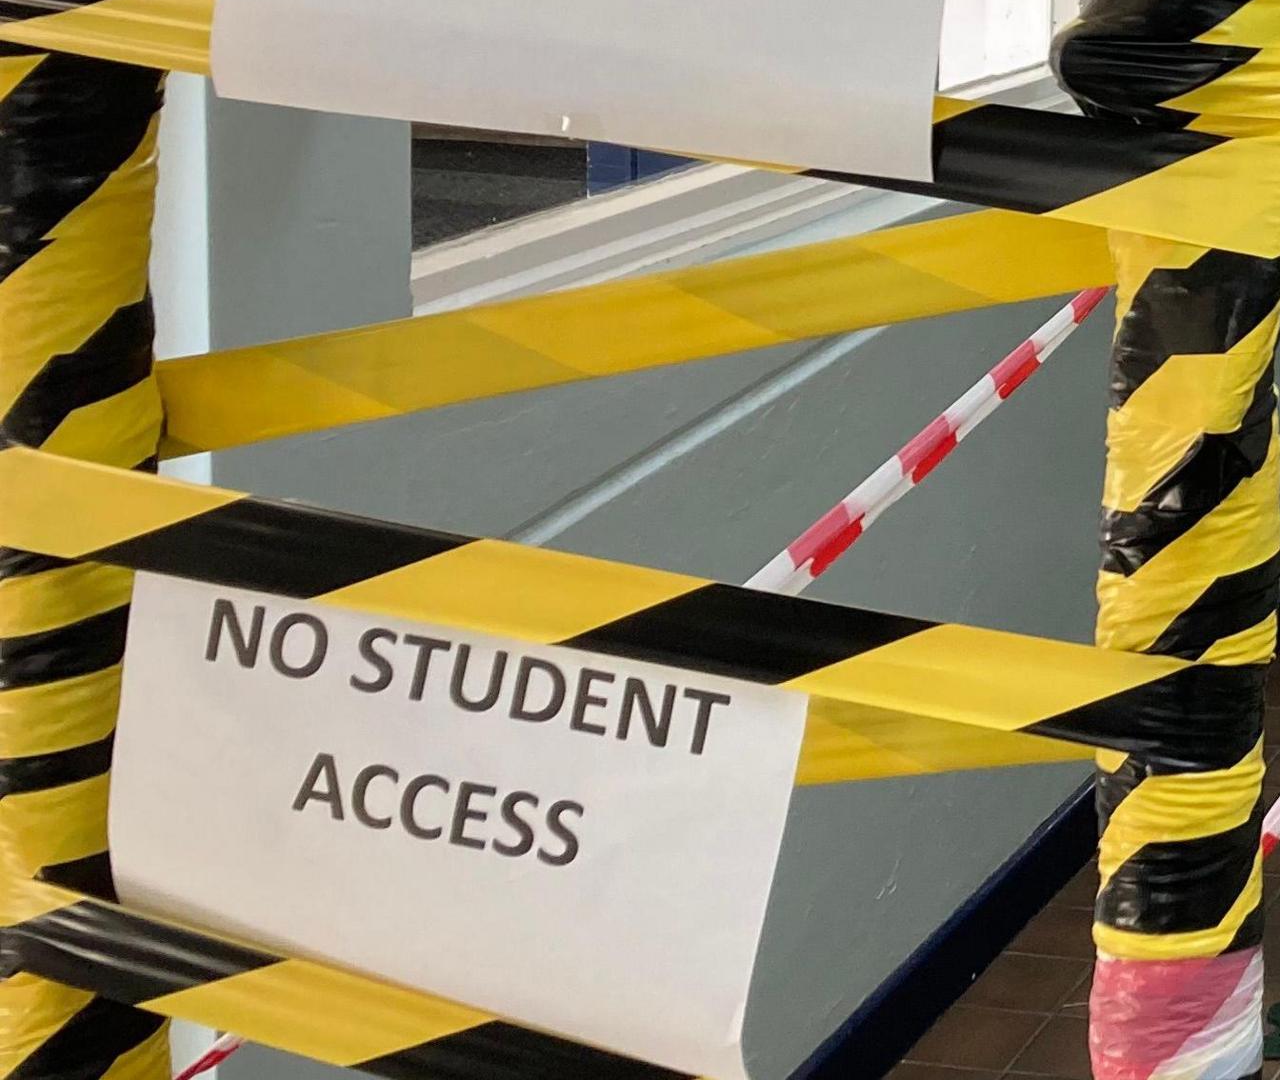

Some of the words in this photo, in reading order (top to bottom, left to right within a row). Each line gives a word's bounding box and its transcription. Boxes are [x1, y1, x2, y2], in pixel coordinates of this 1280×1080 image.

[205, 598, 329, 679] NO
[349, 627, 730, 755] STUDENT
[292, 753, 585, 867] ACCESS
